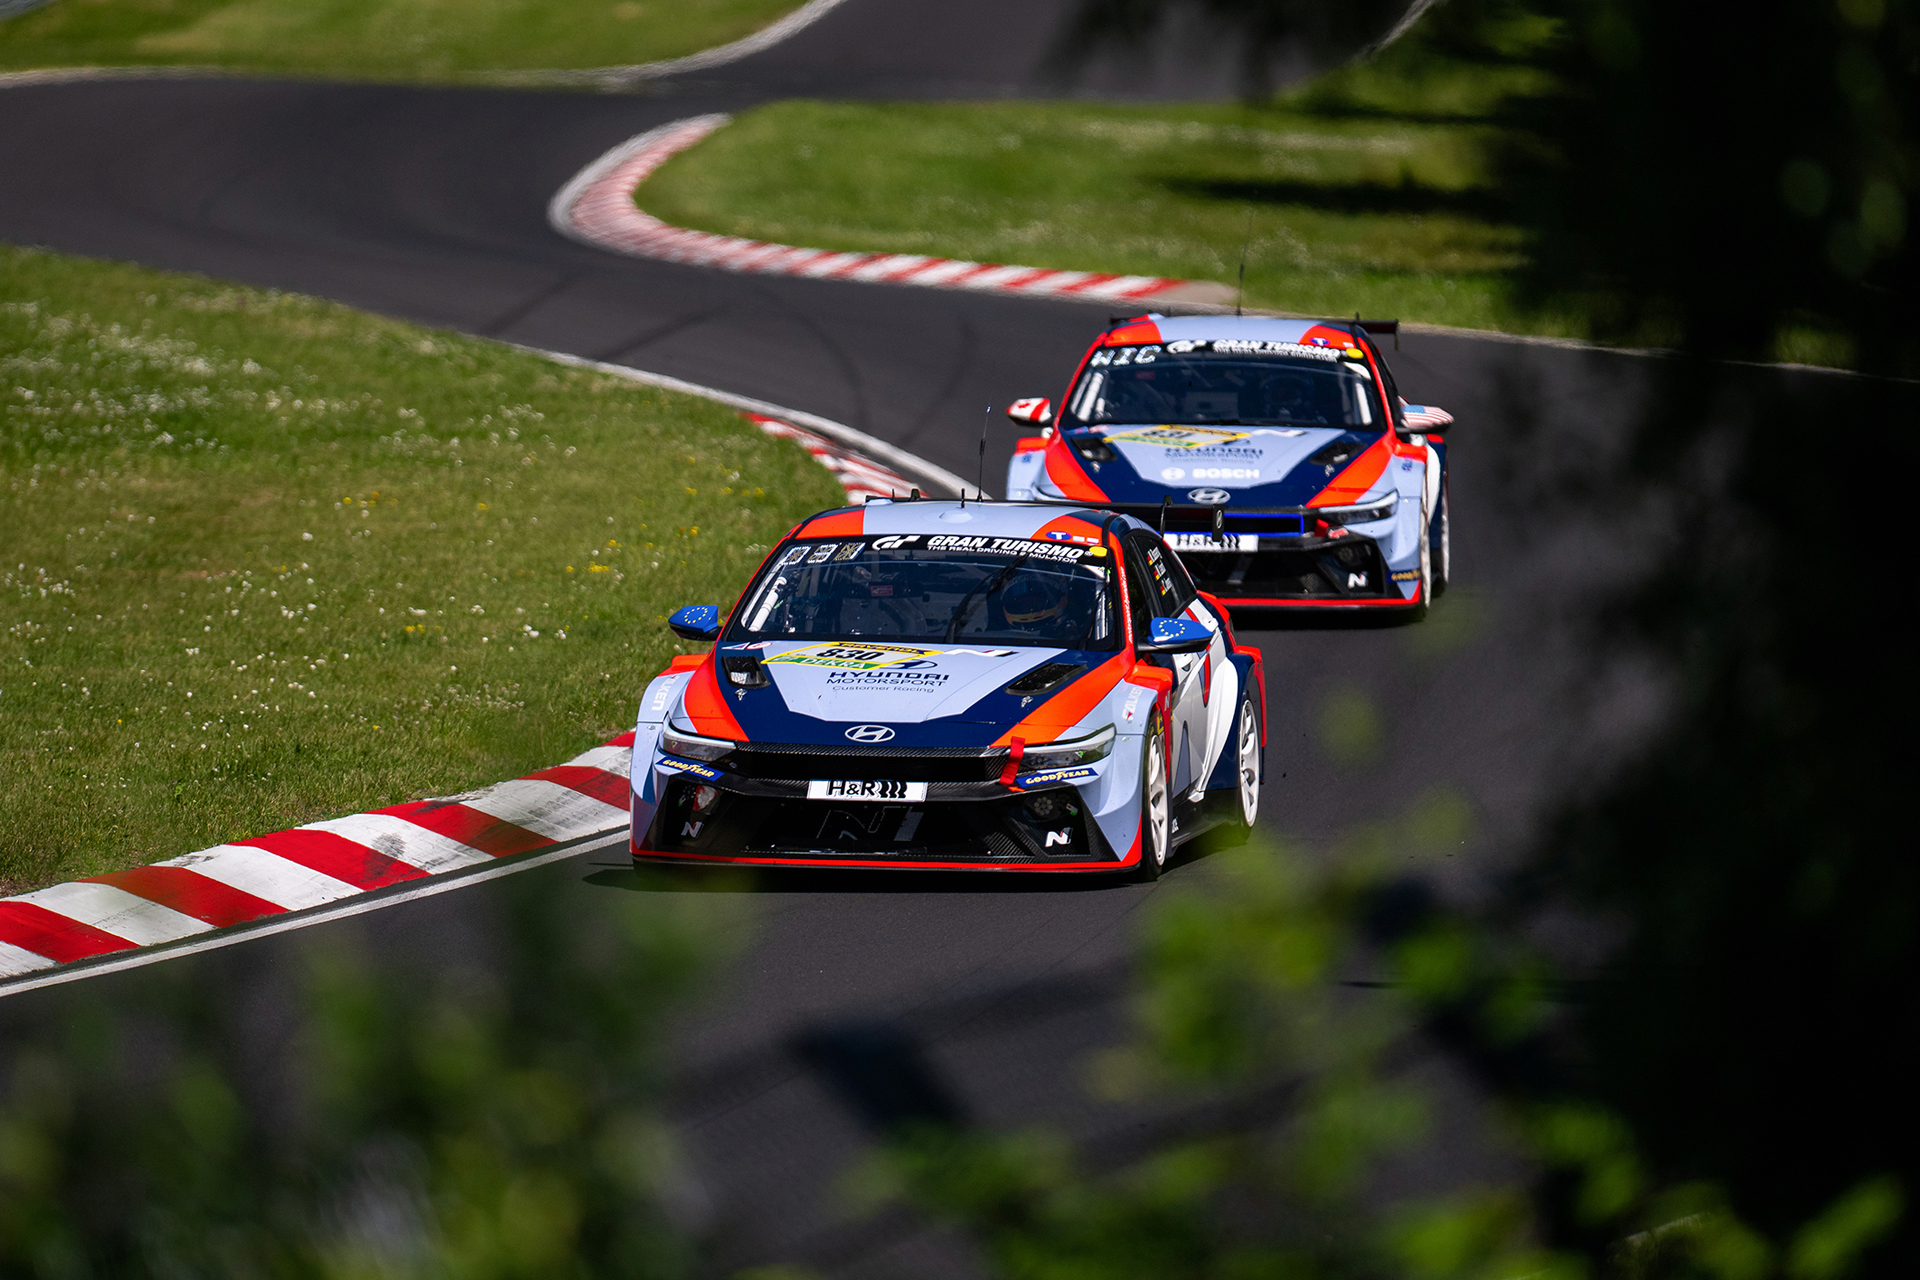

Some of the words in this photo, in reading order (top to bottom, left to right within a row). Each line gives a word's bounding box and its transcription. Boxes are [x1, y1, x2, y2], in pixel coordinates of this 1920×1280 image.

[1212, 339, 1262, 350] GRAN
[1265, 341, 1342, 358] TURISMO
[1192, 468, 1260, 479] BOSCH
[927, 535, 985, 549] GRAN
[990, 538, 1084, 559] TURISMO
[979, 547, 1018, 556] DRIVING
[1019, 551, 1077, 564] SMULATOR
[816, 647, 885, 661] 830
[800, 657, 866, 669] DEKRA
[826, 678, 947, 688] MOTORSPORT
[829, 671, 950, 681] HYUNDAI
[662, 759, 714, 778] GOODYEAR
[1025, 767, 1090, 786] GOODYEAR
[828, 780, 878, 797] H&R
